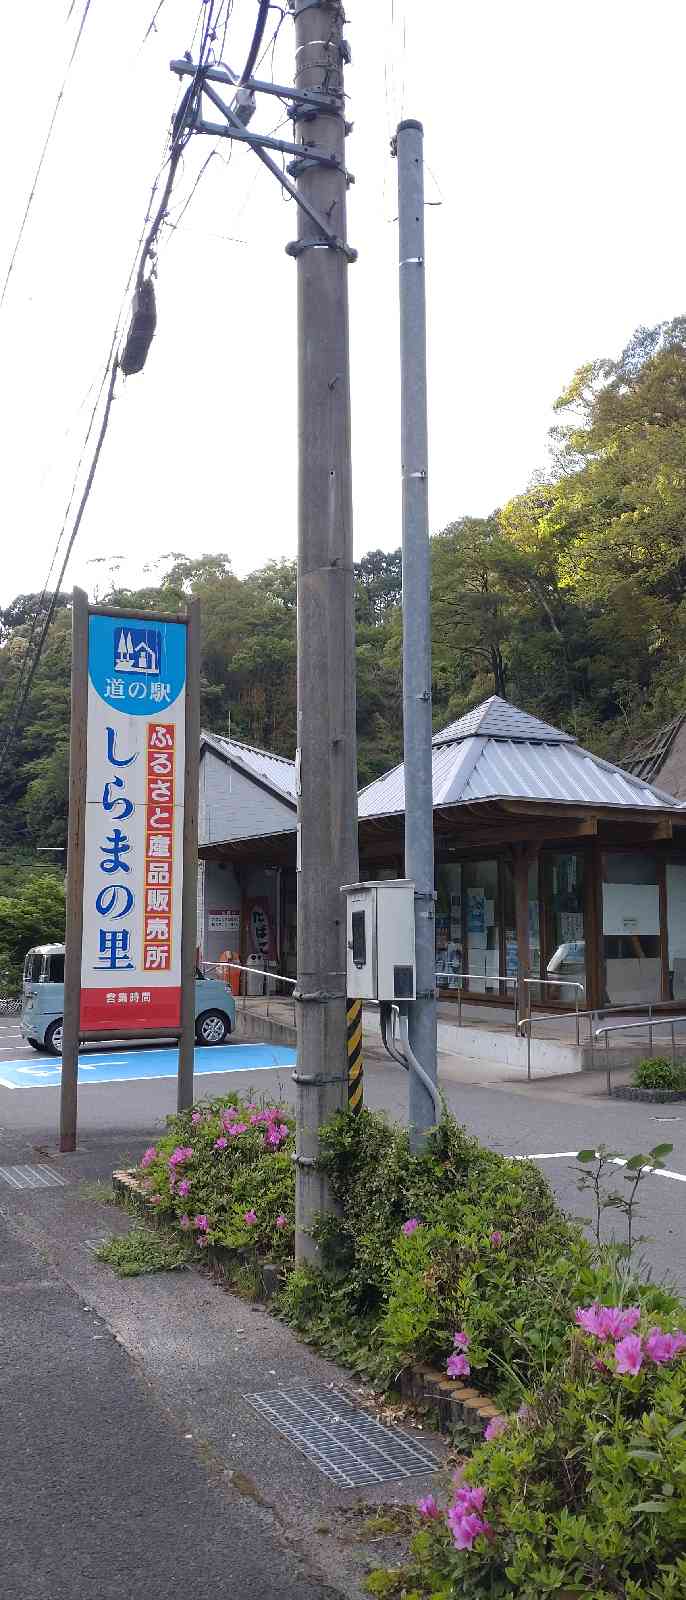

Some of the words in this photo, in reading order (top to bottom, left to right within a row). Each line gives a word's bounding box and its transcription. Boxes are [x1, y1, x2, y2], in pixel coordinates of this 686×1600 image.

[104, 678, 171, 702] 道の駅
[94, 726, 138, 971] しらまの里
[146, 725, 173, 969] ふるさと産品販売所
[106, 992, 151, 1004] 営業時間
